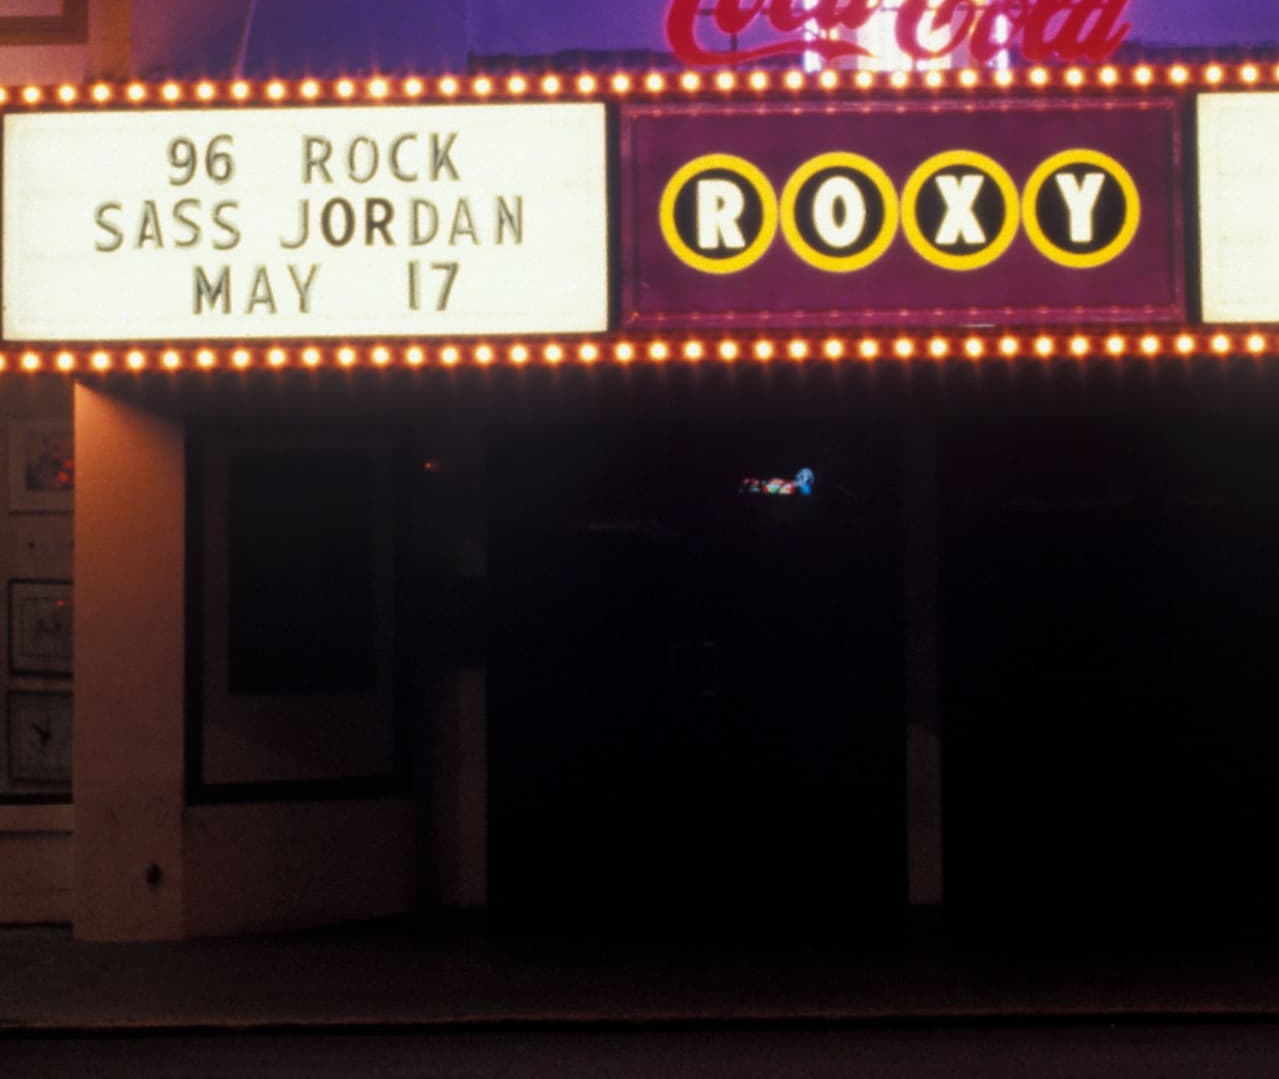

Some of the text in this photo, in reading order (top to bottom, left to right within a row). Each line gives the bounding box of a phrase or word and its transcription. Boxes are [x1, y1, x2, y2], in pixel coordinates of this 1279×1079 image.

[167, 131, 462, 186] 96 ROCK
[93, 194, 526, 253] SASS JORDAN
[695, 171, 1108, 251] ROXY
[191, 259, 461, 315] MAY 17
